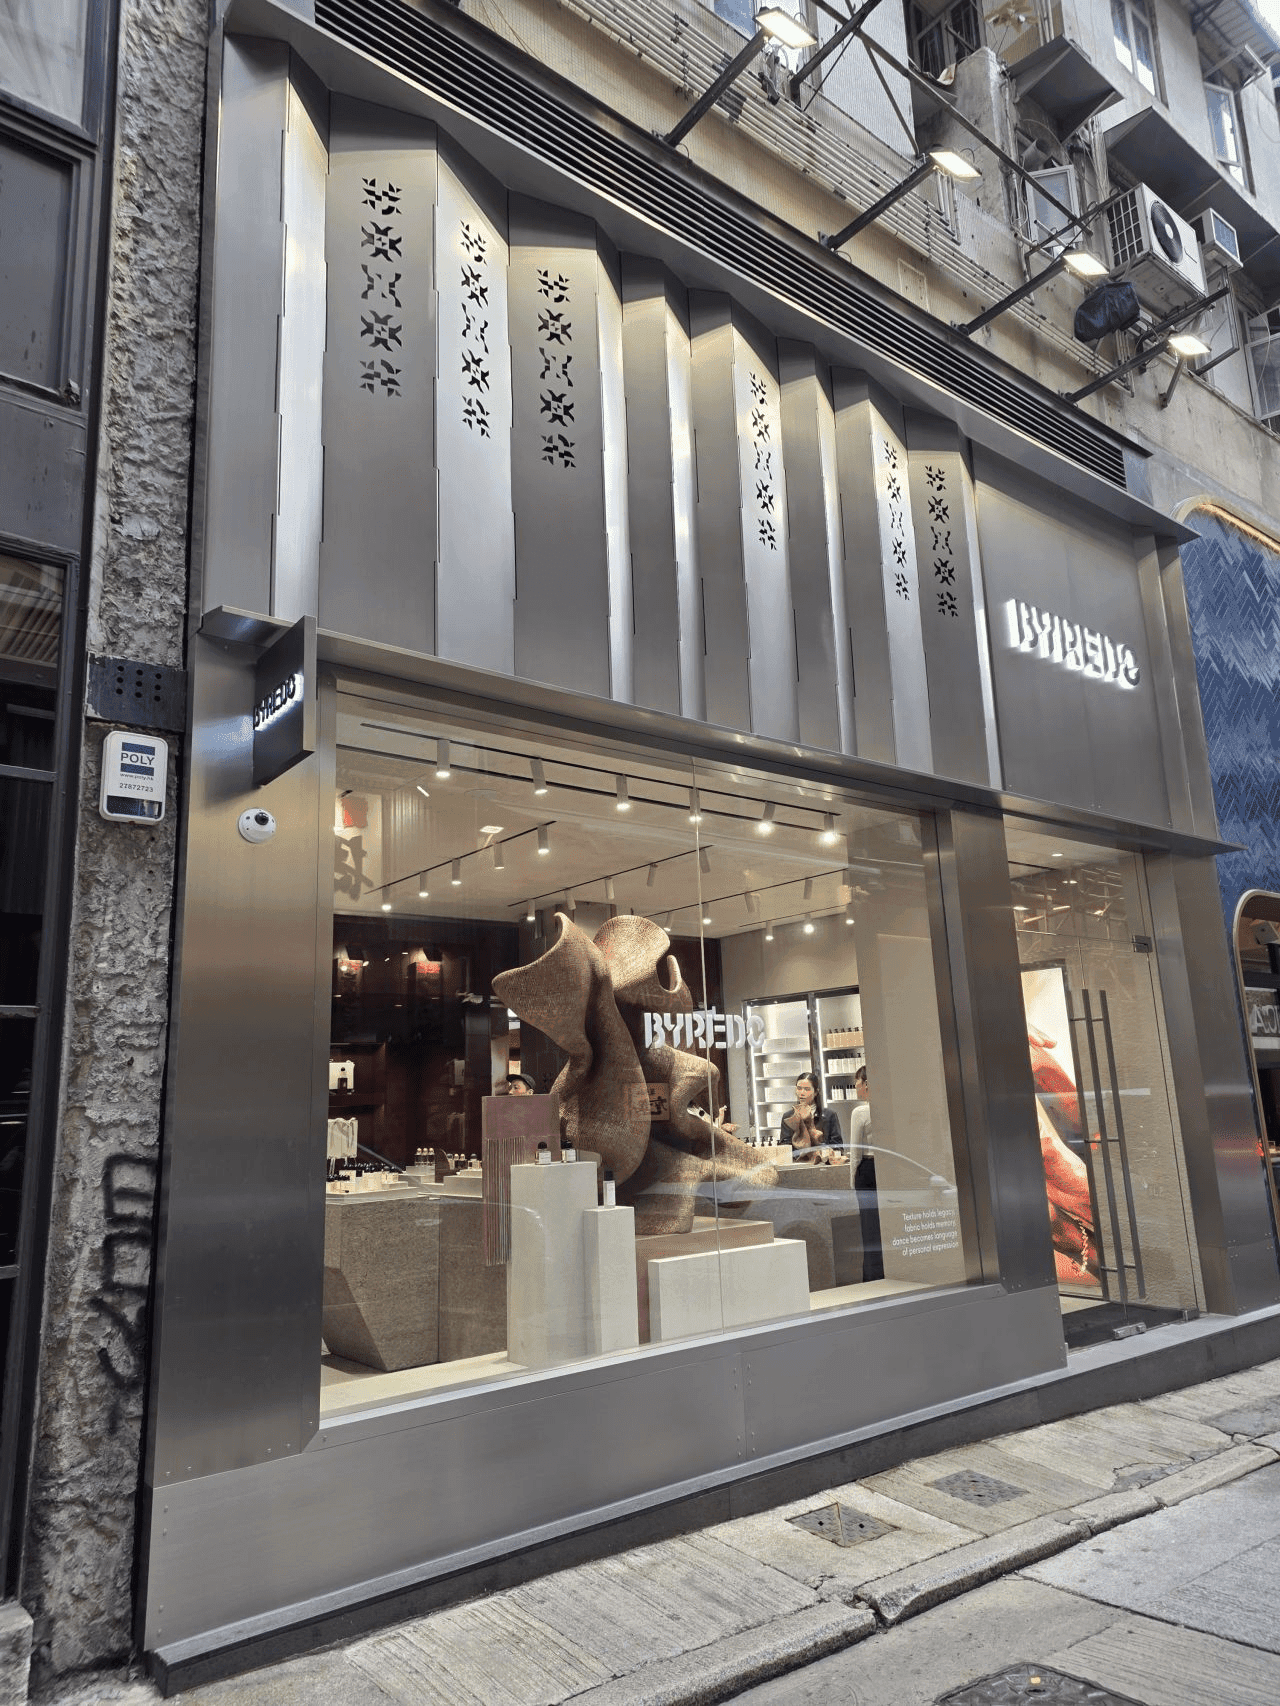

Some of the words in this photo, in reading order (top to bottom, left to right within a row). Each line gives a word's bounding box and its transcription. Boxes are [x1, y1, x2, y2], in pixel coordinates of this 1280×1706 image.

[1004, 597, 1141, 691] BYREDO
[252, 672, 296, 731] BYREDO
[120, 752, 155, 766] POLY
[119, 782, 154, 793] 27872723
[643, 1011, 766, 1049] BYREDO
